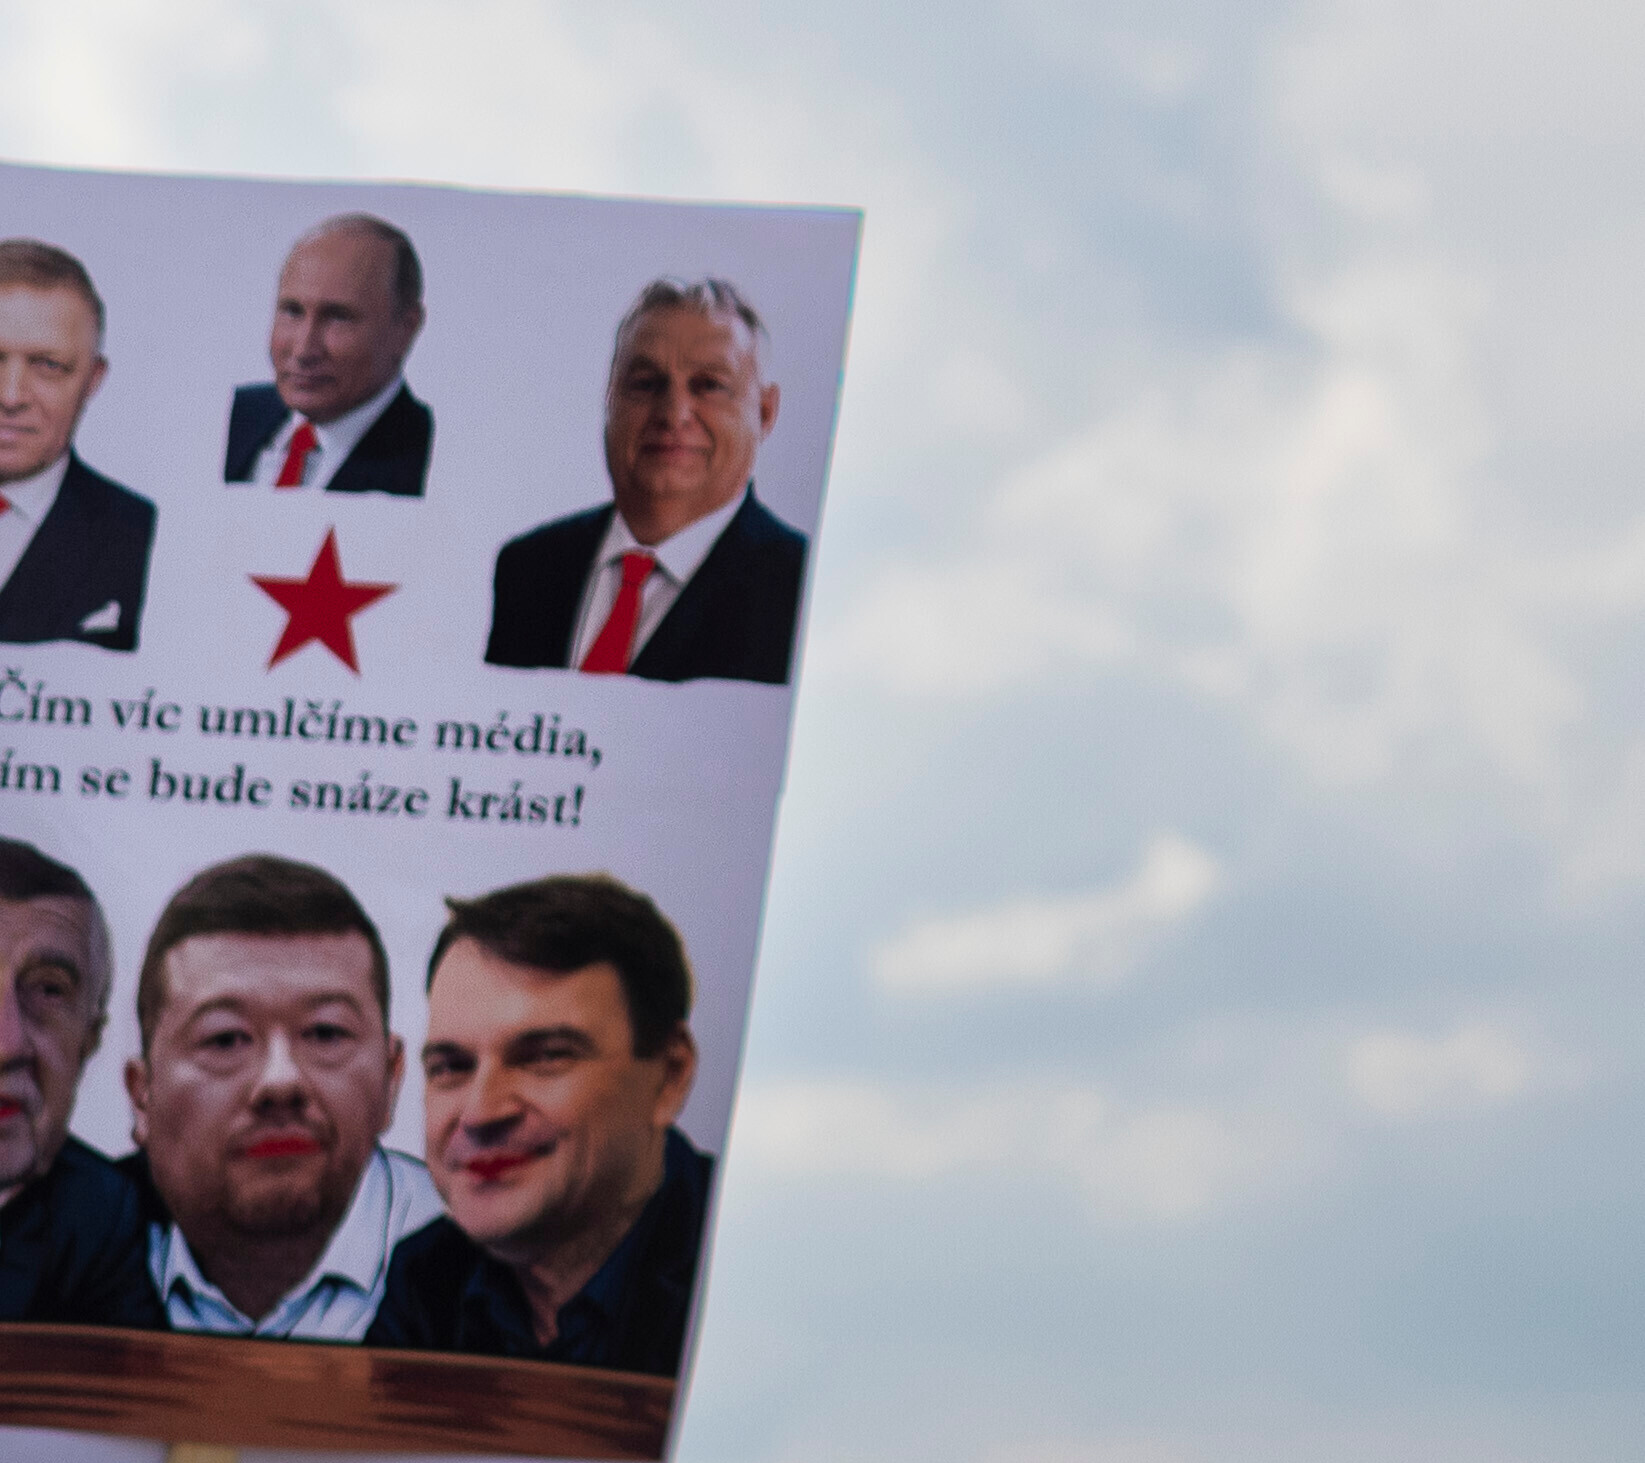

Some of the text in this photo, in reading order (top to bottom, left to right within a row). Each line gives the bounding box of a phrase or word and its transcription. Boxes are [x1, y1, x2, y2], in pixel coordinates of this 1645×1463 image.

[110, 688, 183, 733] víc
[197, 696, 419, 751] umlčíme
[434, 710, 604, 768] média,
[79, 766, 131, 799] se
[147, 756, 273, 808] bude
[288, 771, 430, 819] snáze
[447, 777, 588, 828] krást!
